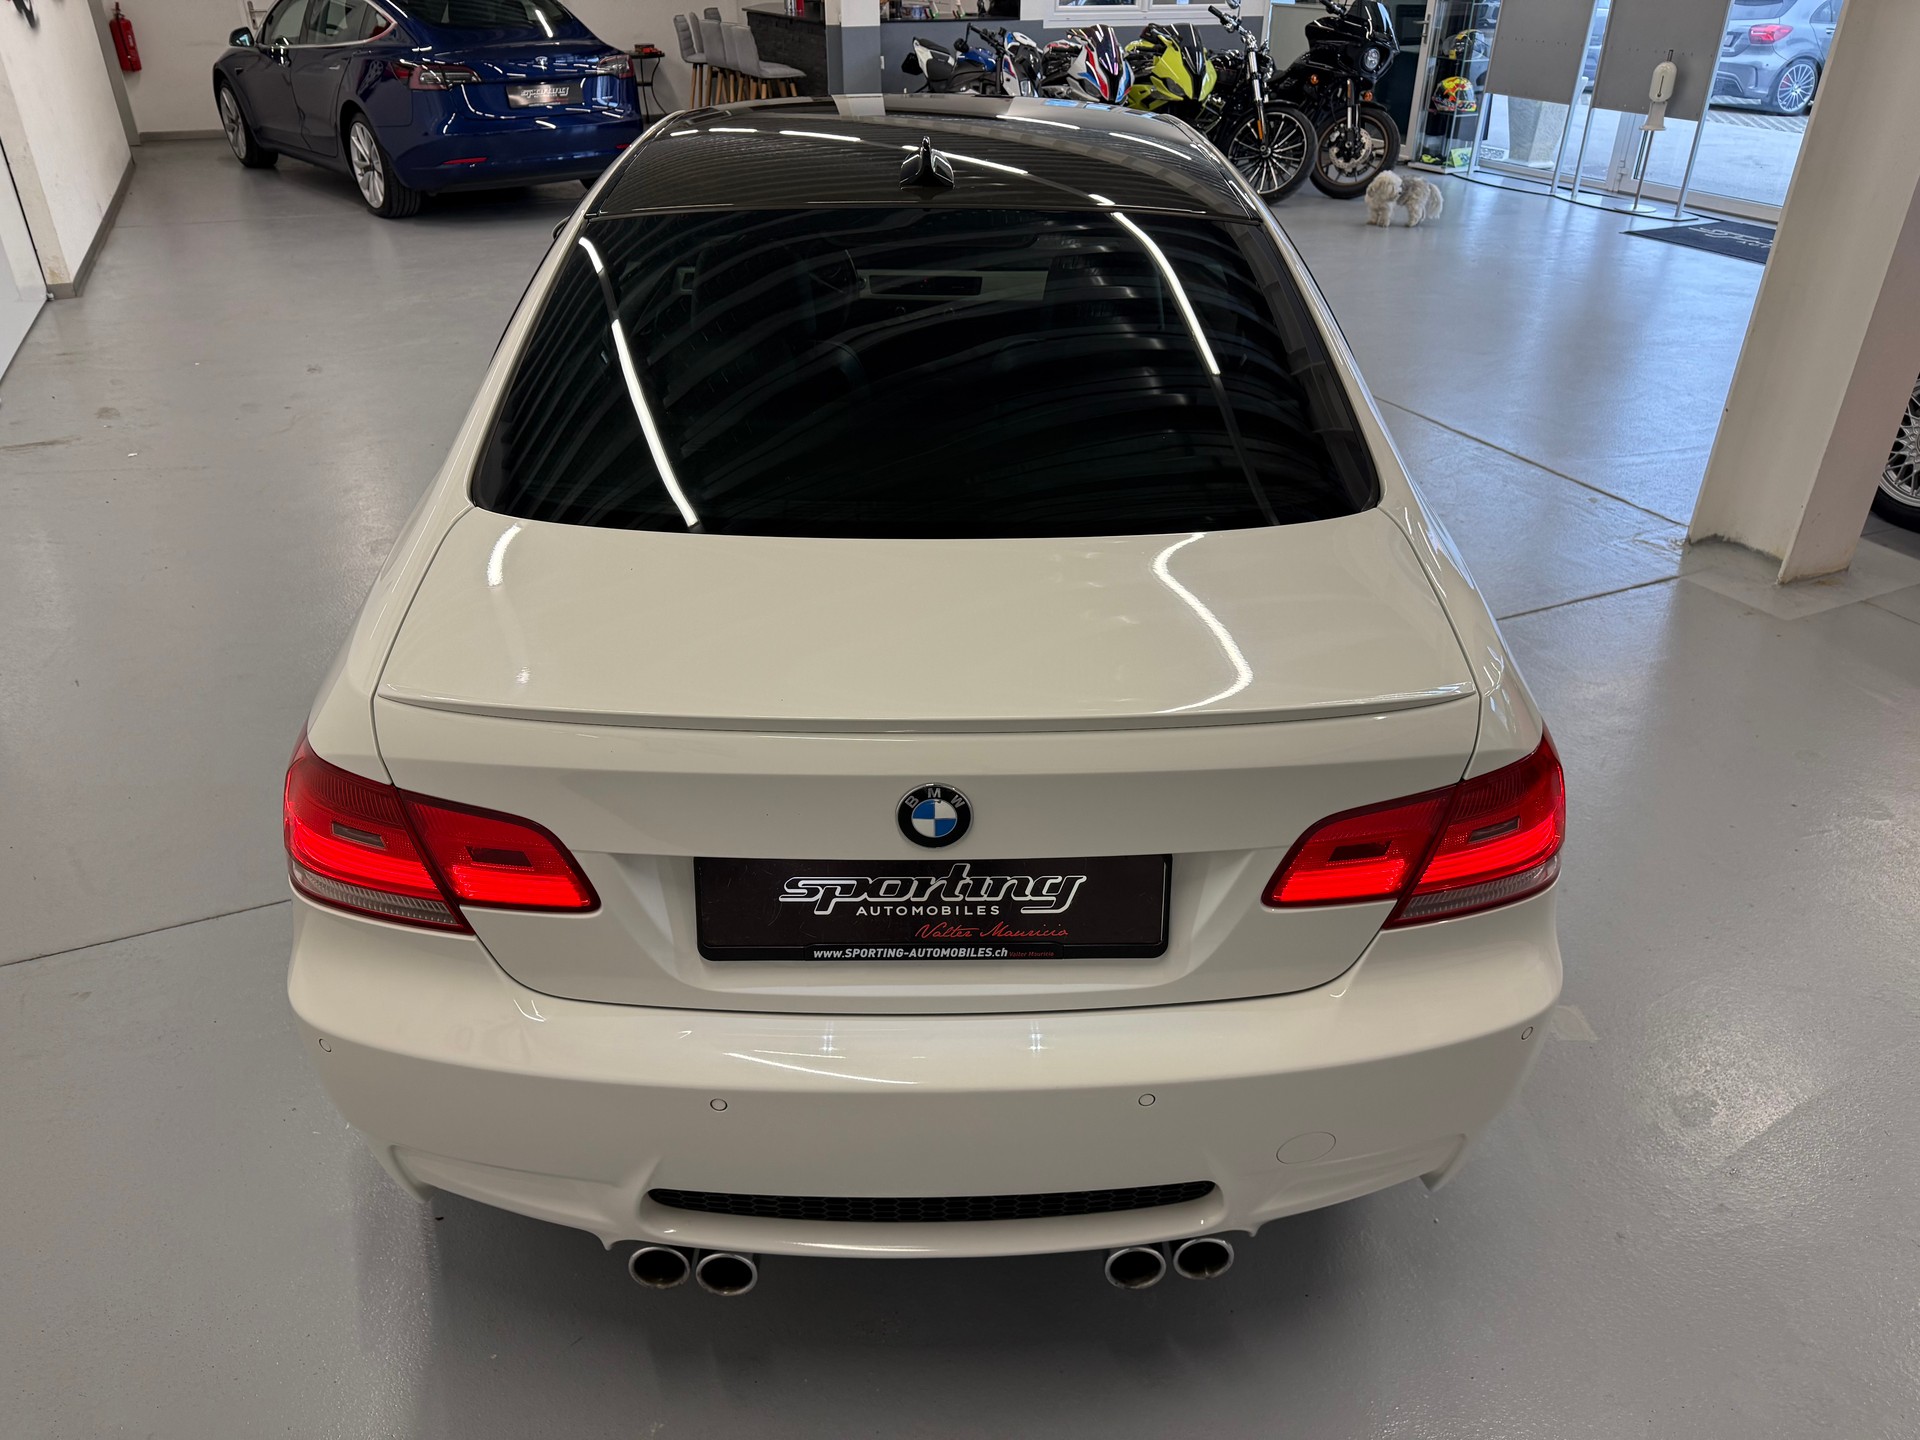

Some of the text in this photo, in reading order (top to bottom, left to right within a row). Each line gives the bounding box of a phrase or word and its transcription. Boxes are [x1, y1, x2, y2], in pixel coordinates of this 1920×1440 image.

[904, 787, 965, 809] BMW
[778, 863, 1088, 915] sporting
[856, 905, 1000, 916] AUTOMOBILES
[914, 921, 1069, 939] Valter Mauricio
[813, 948, 1008, 958] www.SPORTING-AUTOMOBILES.ch
